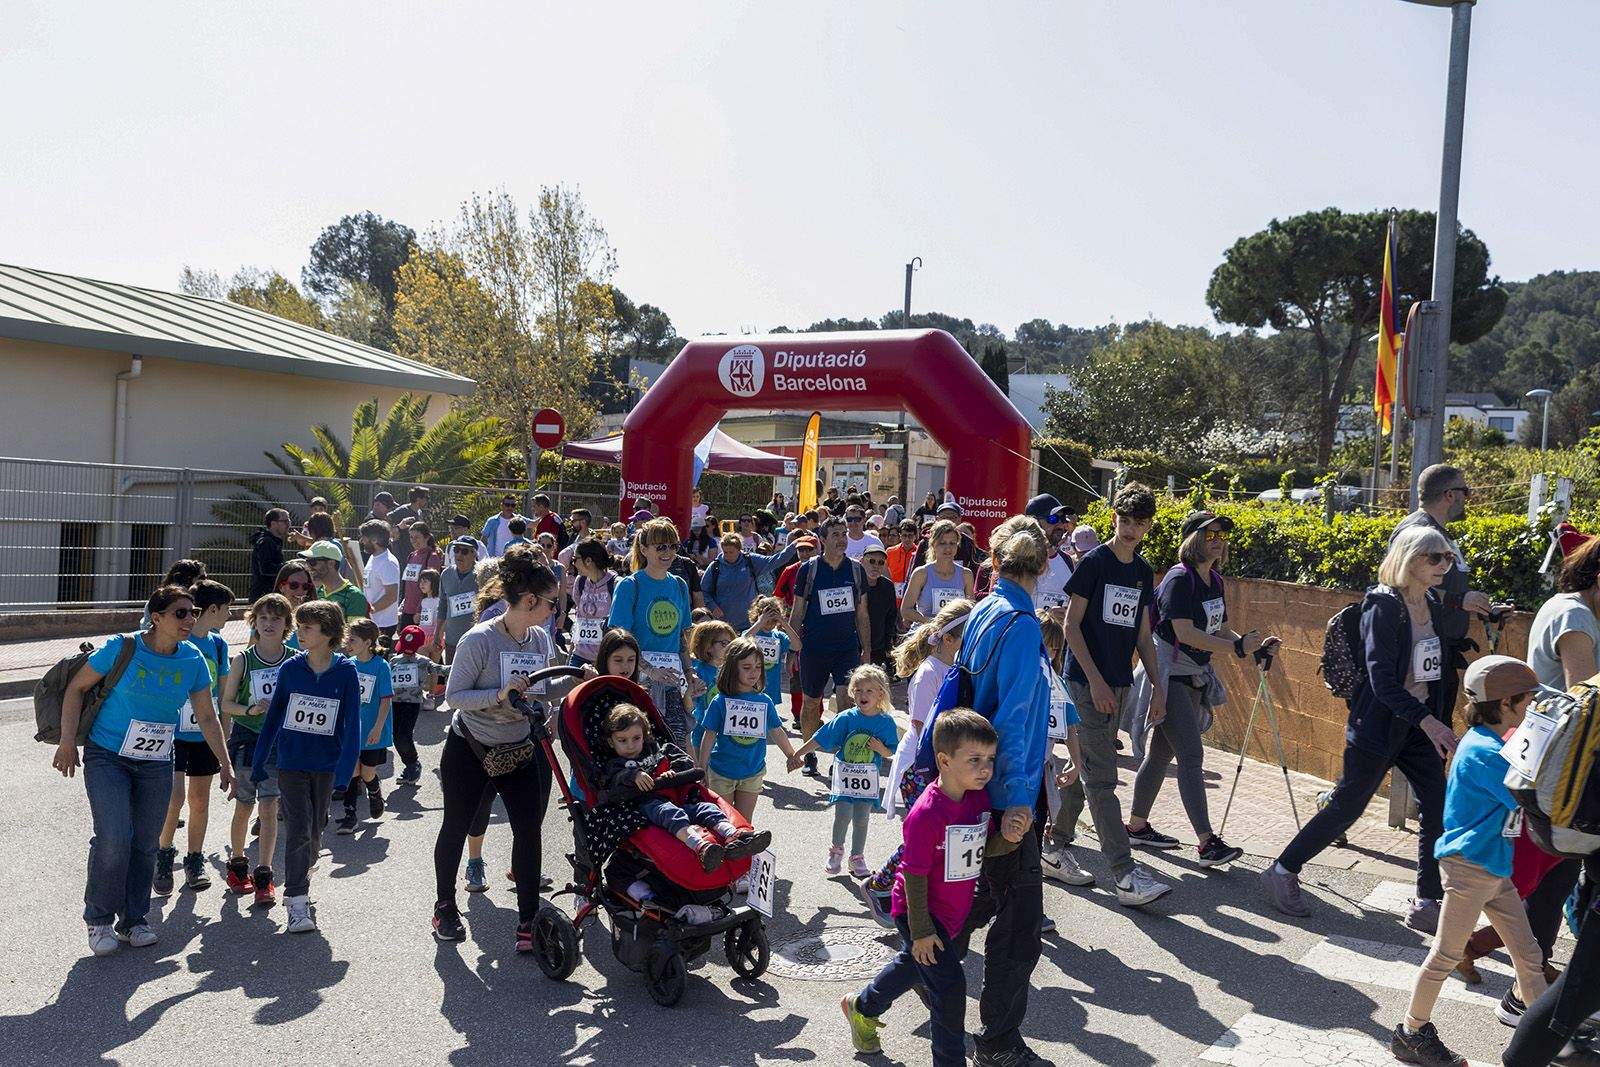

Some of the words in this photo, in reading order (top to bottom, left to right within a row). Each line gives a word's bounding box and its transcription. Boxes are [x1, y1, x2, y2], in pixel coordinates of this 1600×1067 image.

[773, 350, 867, 371] Diputació
[773, 373, 868, 391] Barcelona
[627, 481, 668, 491] Diputació
[626, 490, 668, 500] Barcelona
[959, 496, 1008, 508] Diputació
[959, 507, 1008, 518] Barcelona
[455, 600, 472, 611] 157
[826, 597, 848, 608] 054
[1112, 602, 1137, 618] 061
[579, 629, 598, 639] 032
[761, 647, 776, 657] 53
[1423, 656, 1441, 671] 09
[392, 673, 412, 683] 159
[295, 710, 327, 726] 019
[729, 714, 759, 729] 140
[132, 736, 165, 752] 227
[841, 777, 871, 790] 180
[758, 860, 771, 902] 222
